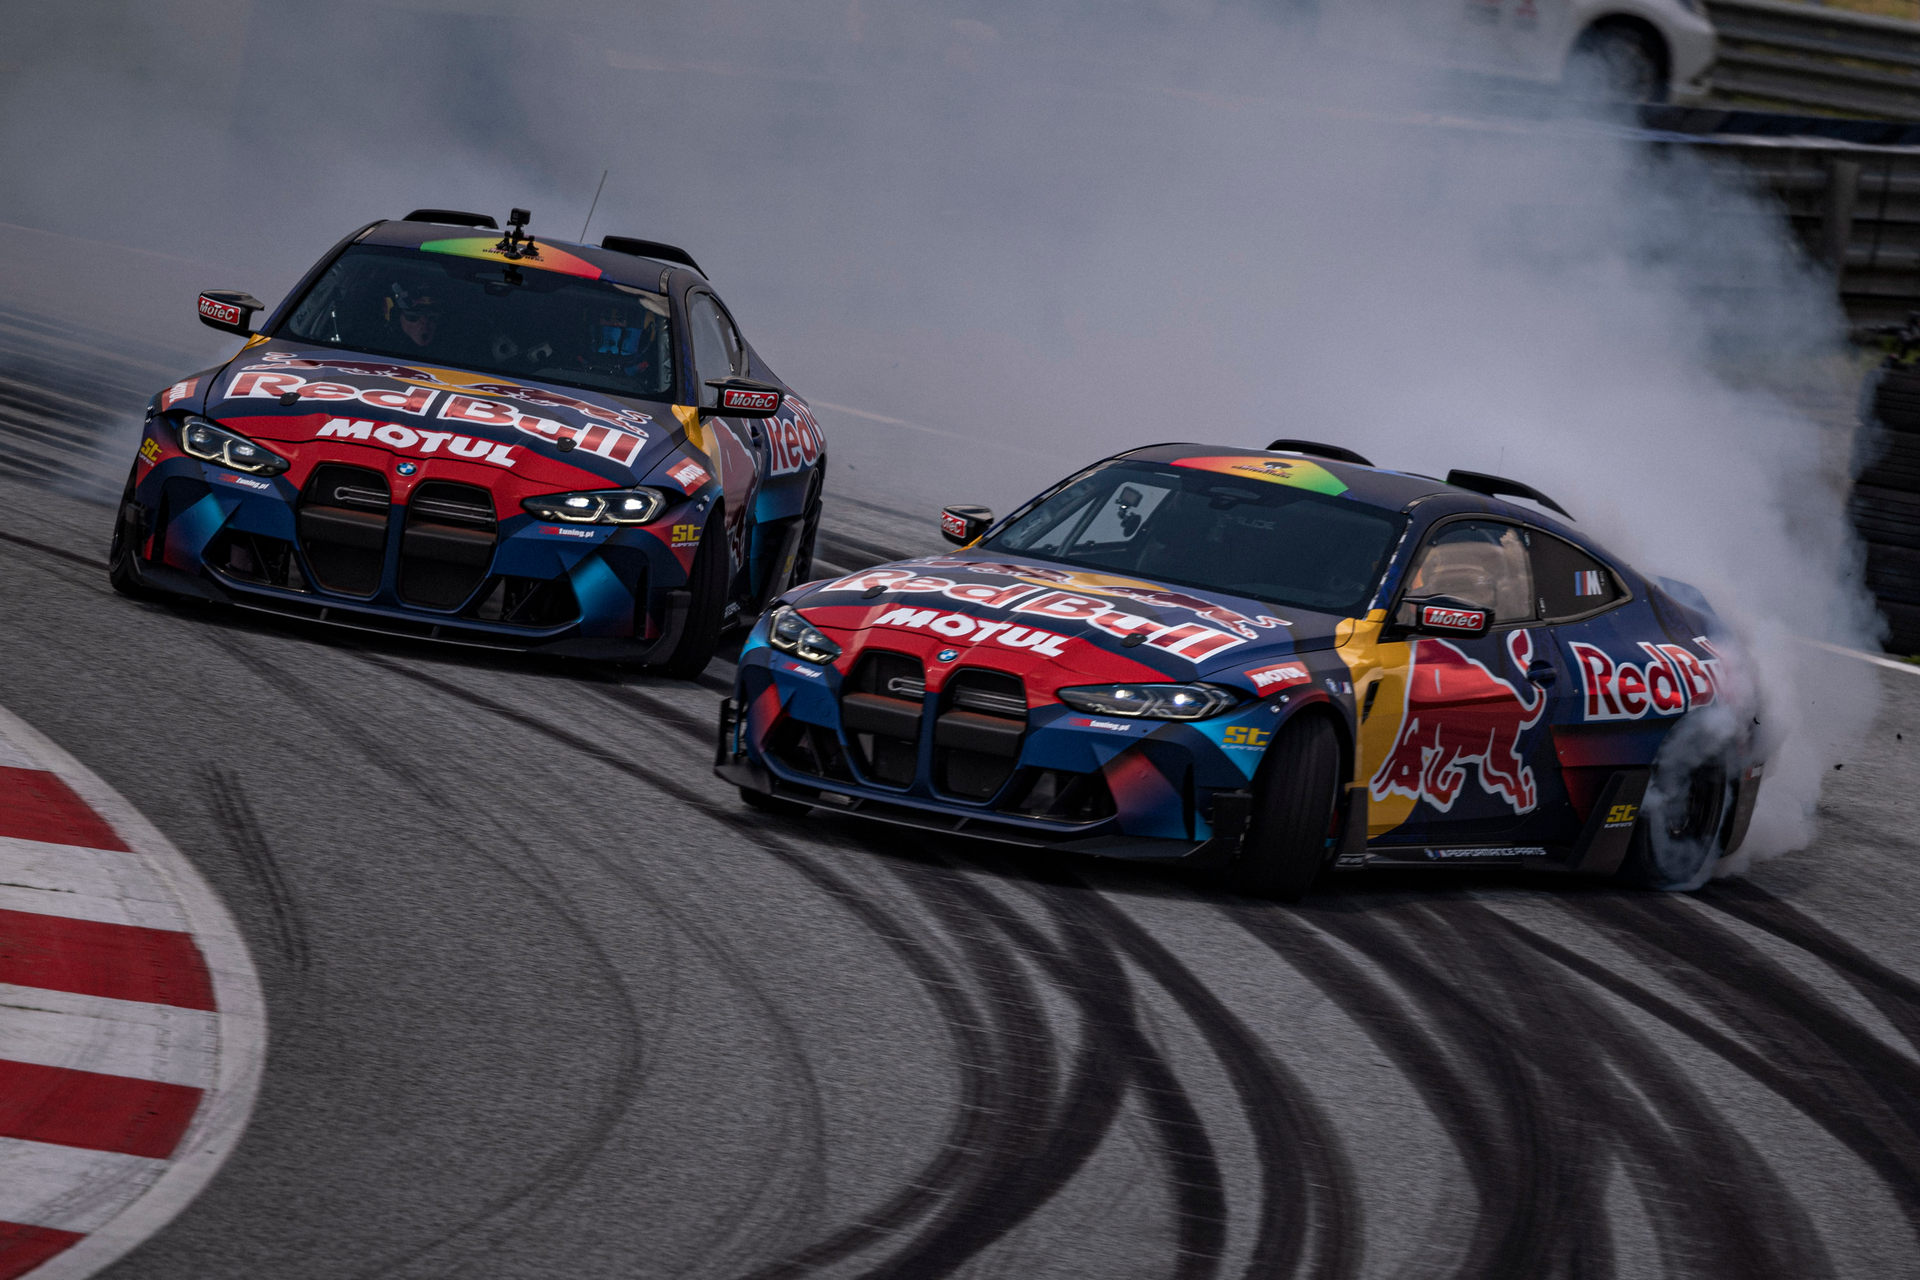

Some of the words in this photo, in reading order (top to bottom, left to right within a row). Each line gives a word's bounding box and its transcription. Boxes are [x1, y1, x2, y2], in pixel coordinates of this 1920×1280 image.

[200, 300, 236, 321] MoTeC
[223, 371, 441, 417] Red
[437, 393, 649, 468] Bull
[730, 392, 776, 409] MoTeC
[316, 418, 517, 467] MOTUL
[819, 569, 1047, 609] Red
[1010, 591, 1248, 665] Bull
[873, 607, 1070, 658] MOTUL
[1429, 610, 1481, 628] MoTeC
[1251, 667, 1307, 688] MOTUL
[1568, 641, 1687, 721] Red
